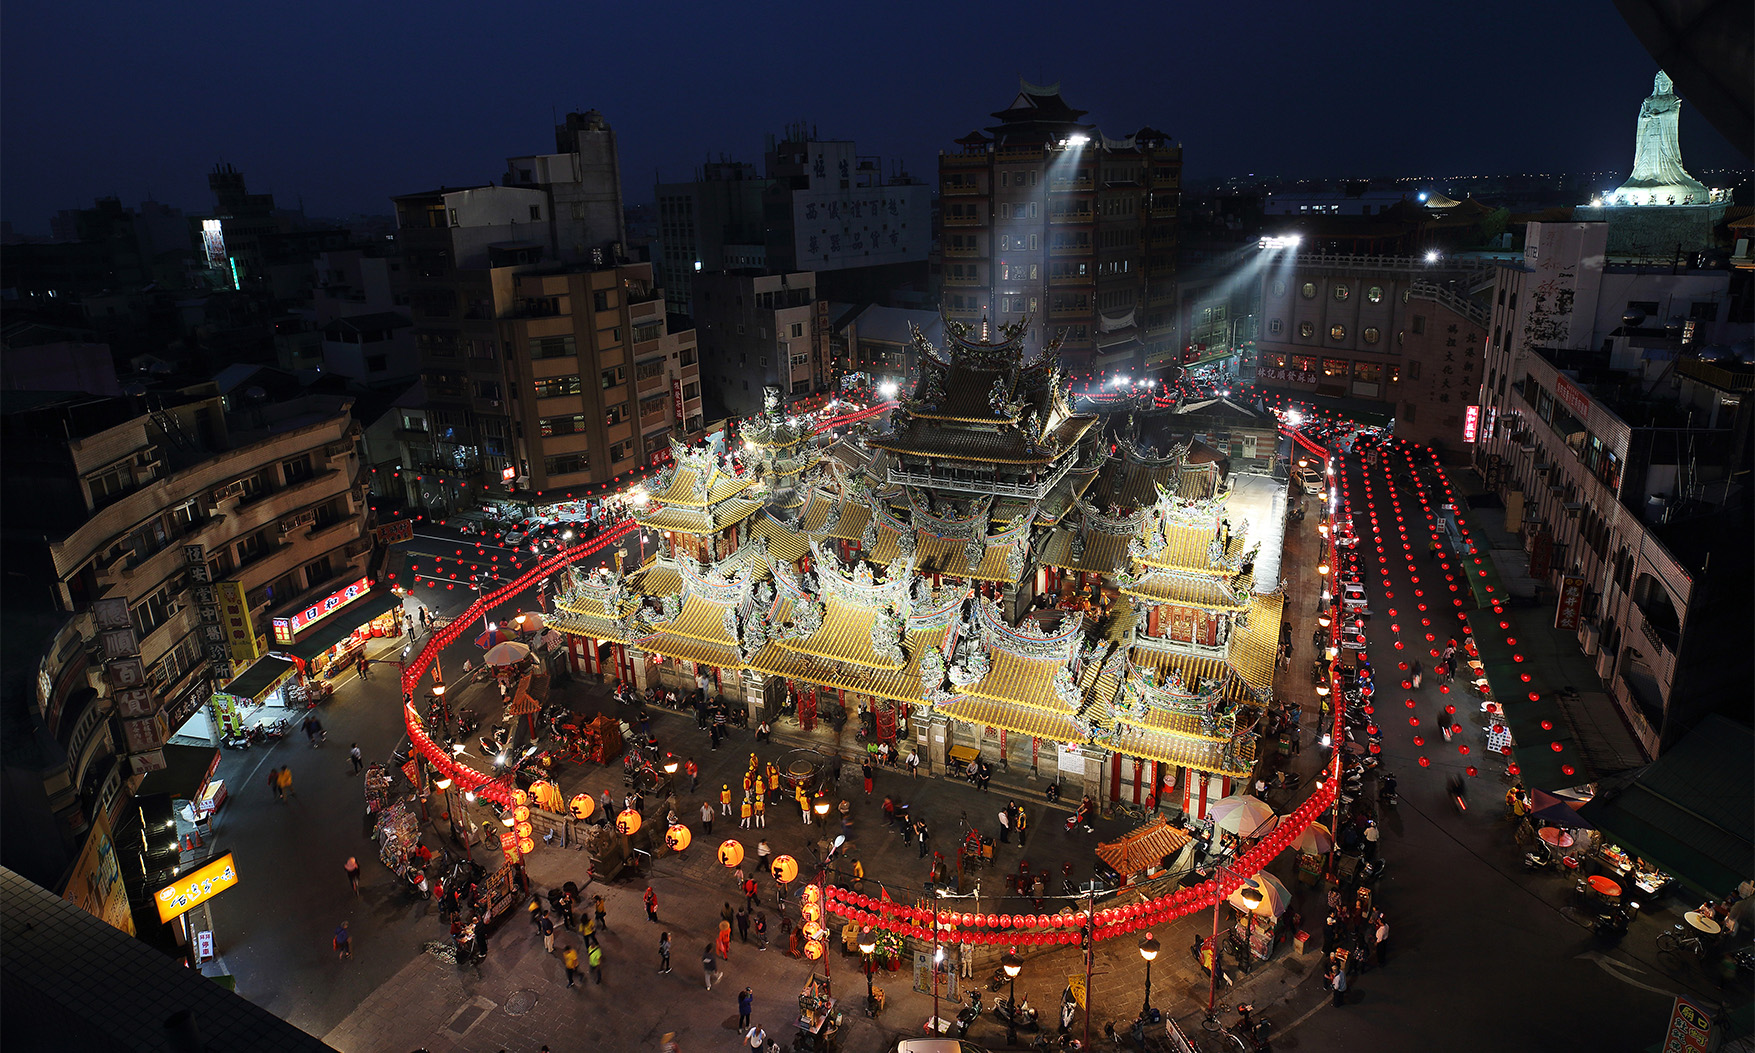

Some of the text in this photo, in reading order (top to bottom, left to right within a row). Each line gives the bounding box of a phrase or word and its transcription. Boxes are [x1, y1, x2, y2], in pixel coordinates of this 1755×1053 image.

[1461, 332, 1477, 401] 北港朝天宮
